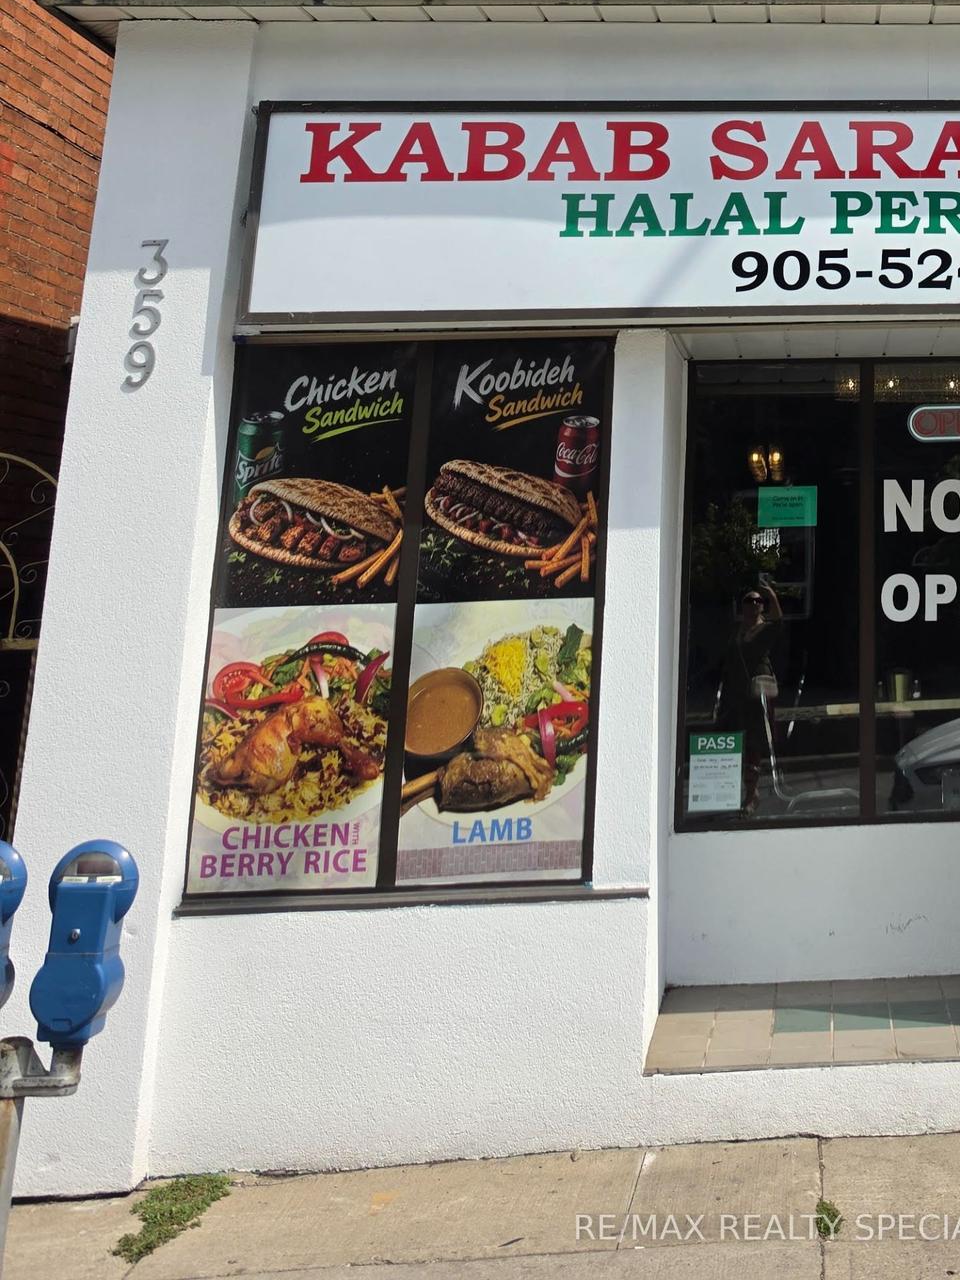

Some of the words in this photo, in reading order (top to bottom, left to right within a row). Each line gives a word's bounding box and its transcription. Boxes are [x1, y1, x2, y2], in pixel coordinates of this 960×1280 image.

[300, 120, 672, 184] KABAB
[558, 190, 807, 238] HALAL
[123, 238, 170, 390] 359
[283, 365, 398, 413] Chicken
[453, 355, 576, 410] Koobideh
[484, 382, 584, 423] Sandwich
[302, 391, 404, 434] Sandwich
[697, 735, 736, 751] PASS
[221, 822, 351, 852] CHICKEN
[452, 817, 534, 845] LAMB
[199, 851, 293, 879] BERRY
[304, 848, 368, 874] RICE
